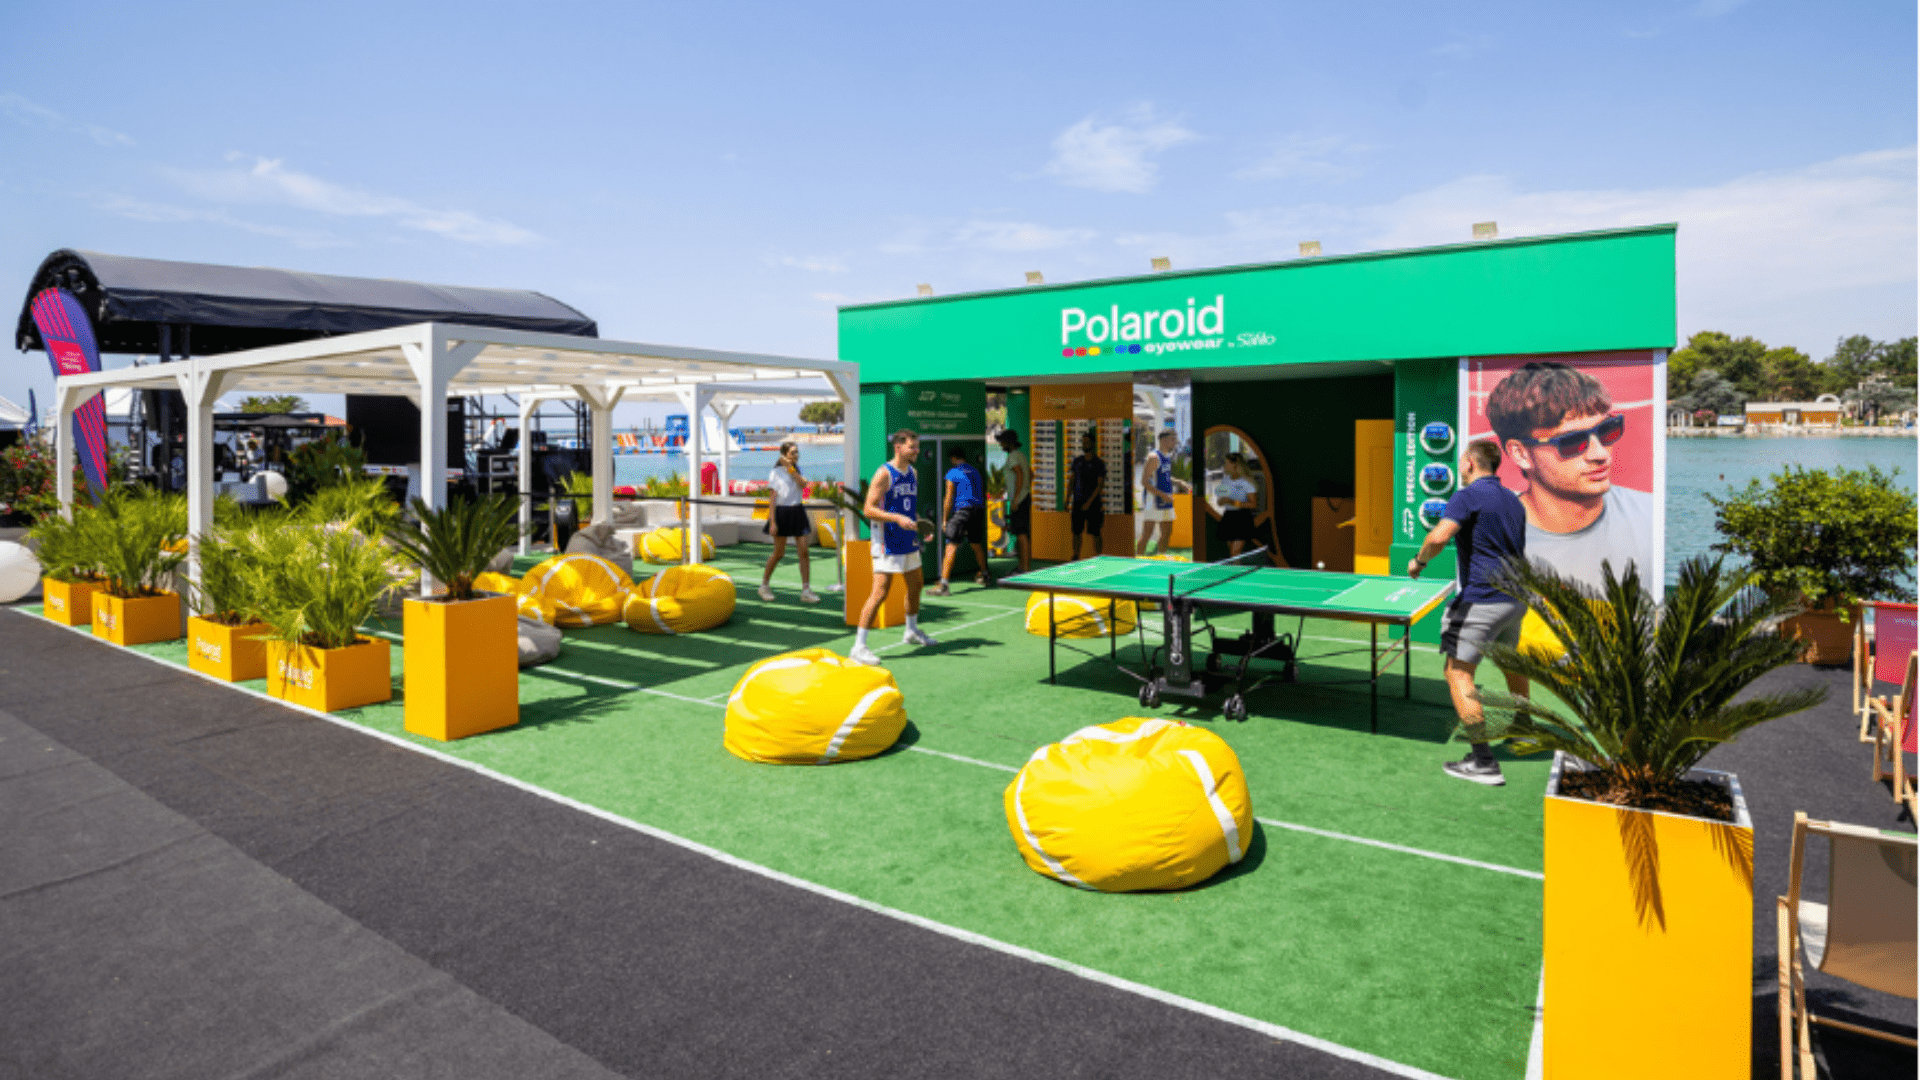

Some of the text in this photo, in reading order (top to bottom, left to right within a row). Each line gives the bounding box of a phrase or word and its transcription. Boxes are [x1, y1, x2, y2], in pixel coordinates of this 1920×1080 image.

[1061, 294, 1224, 345] Polaroid
[1144, 338, 1224, 355] eyewear
[1402, 411, 1415, 540] ATP SPECIAL EDITION
[903, 497, 912, 511] 0
